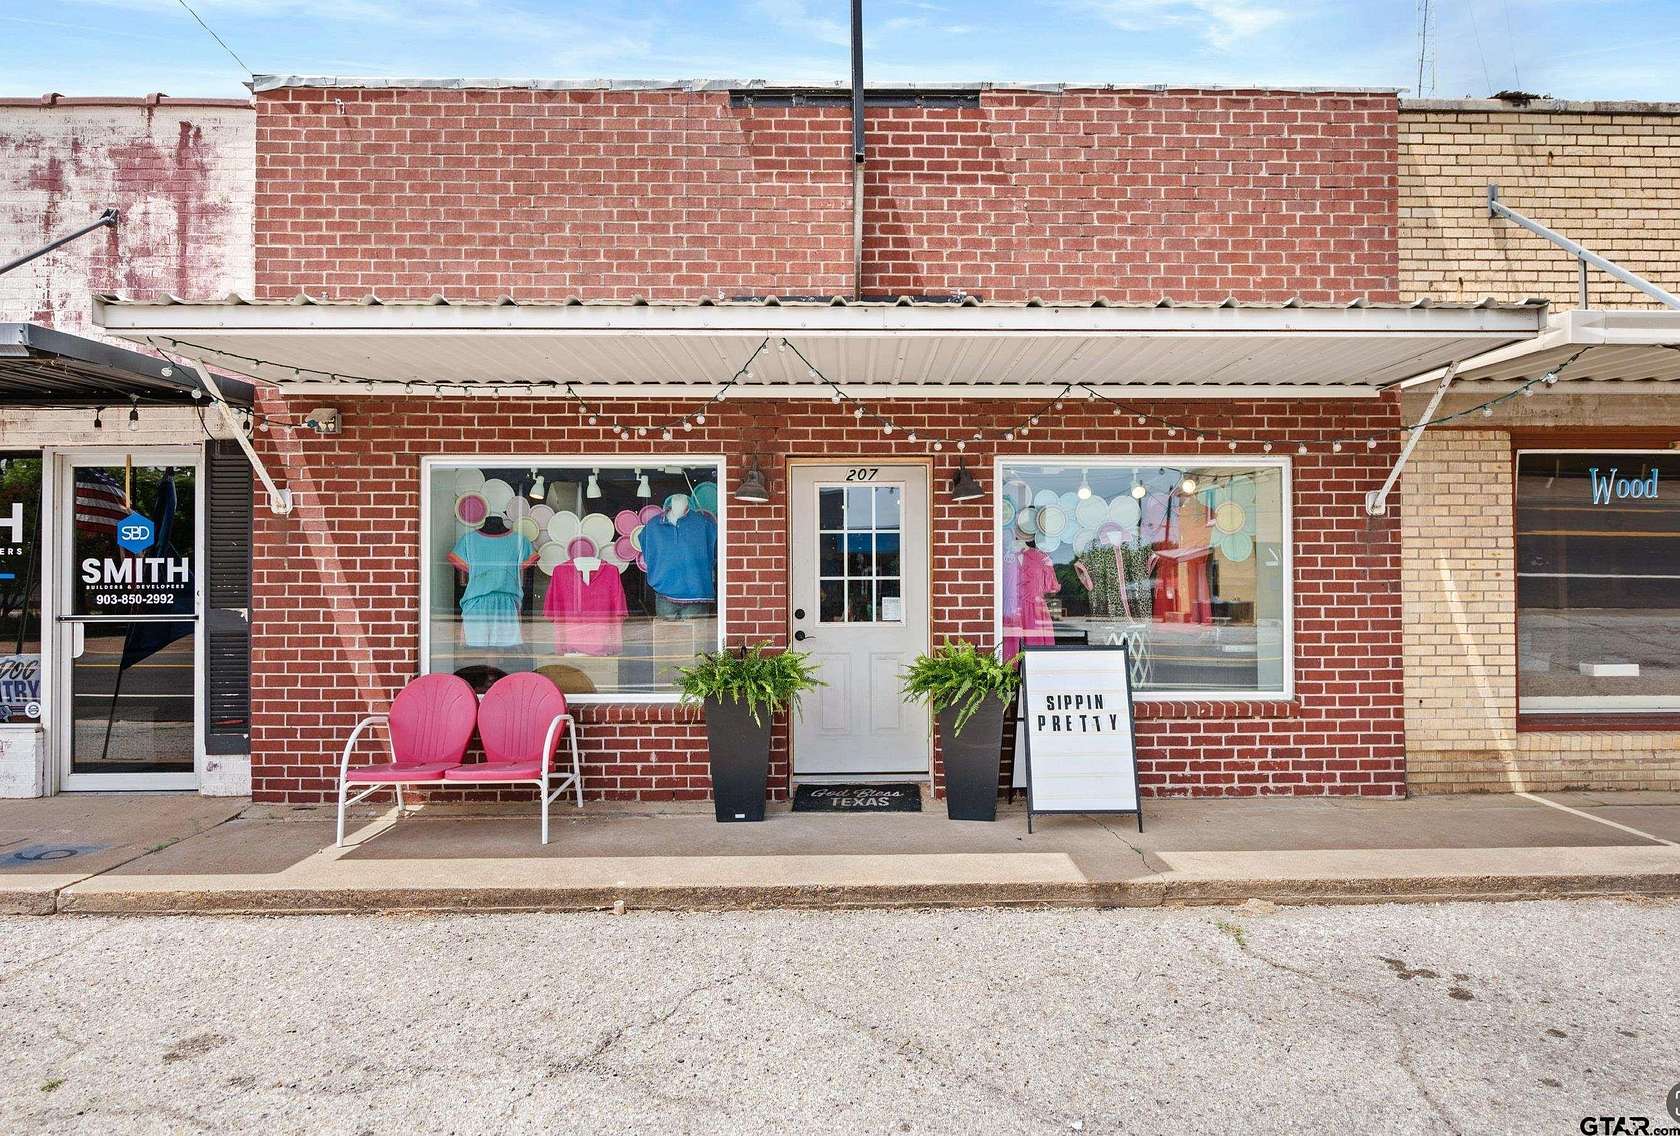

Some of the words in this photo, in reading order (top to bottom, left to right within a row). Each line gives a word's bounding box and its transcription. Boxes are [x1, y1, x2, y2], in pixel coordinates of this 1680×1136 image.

[846, 468, 879, 481] 207
[1589, 468, 1659, 504] Wood
[121, 526, 150, 540] SBD
[81, 557, 189, 584] SMITH
[96, 594, 174, 605] 903-850-2992
[1046, 694, 1104, 711] SIPPIN
[1037, 714, 1117, 732] PRETTY
[810, 788, 851, 798] God
[853, 788, 905, 798] Bless
[830, 797, 890, 807] TEXAS
